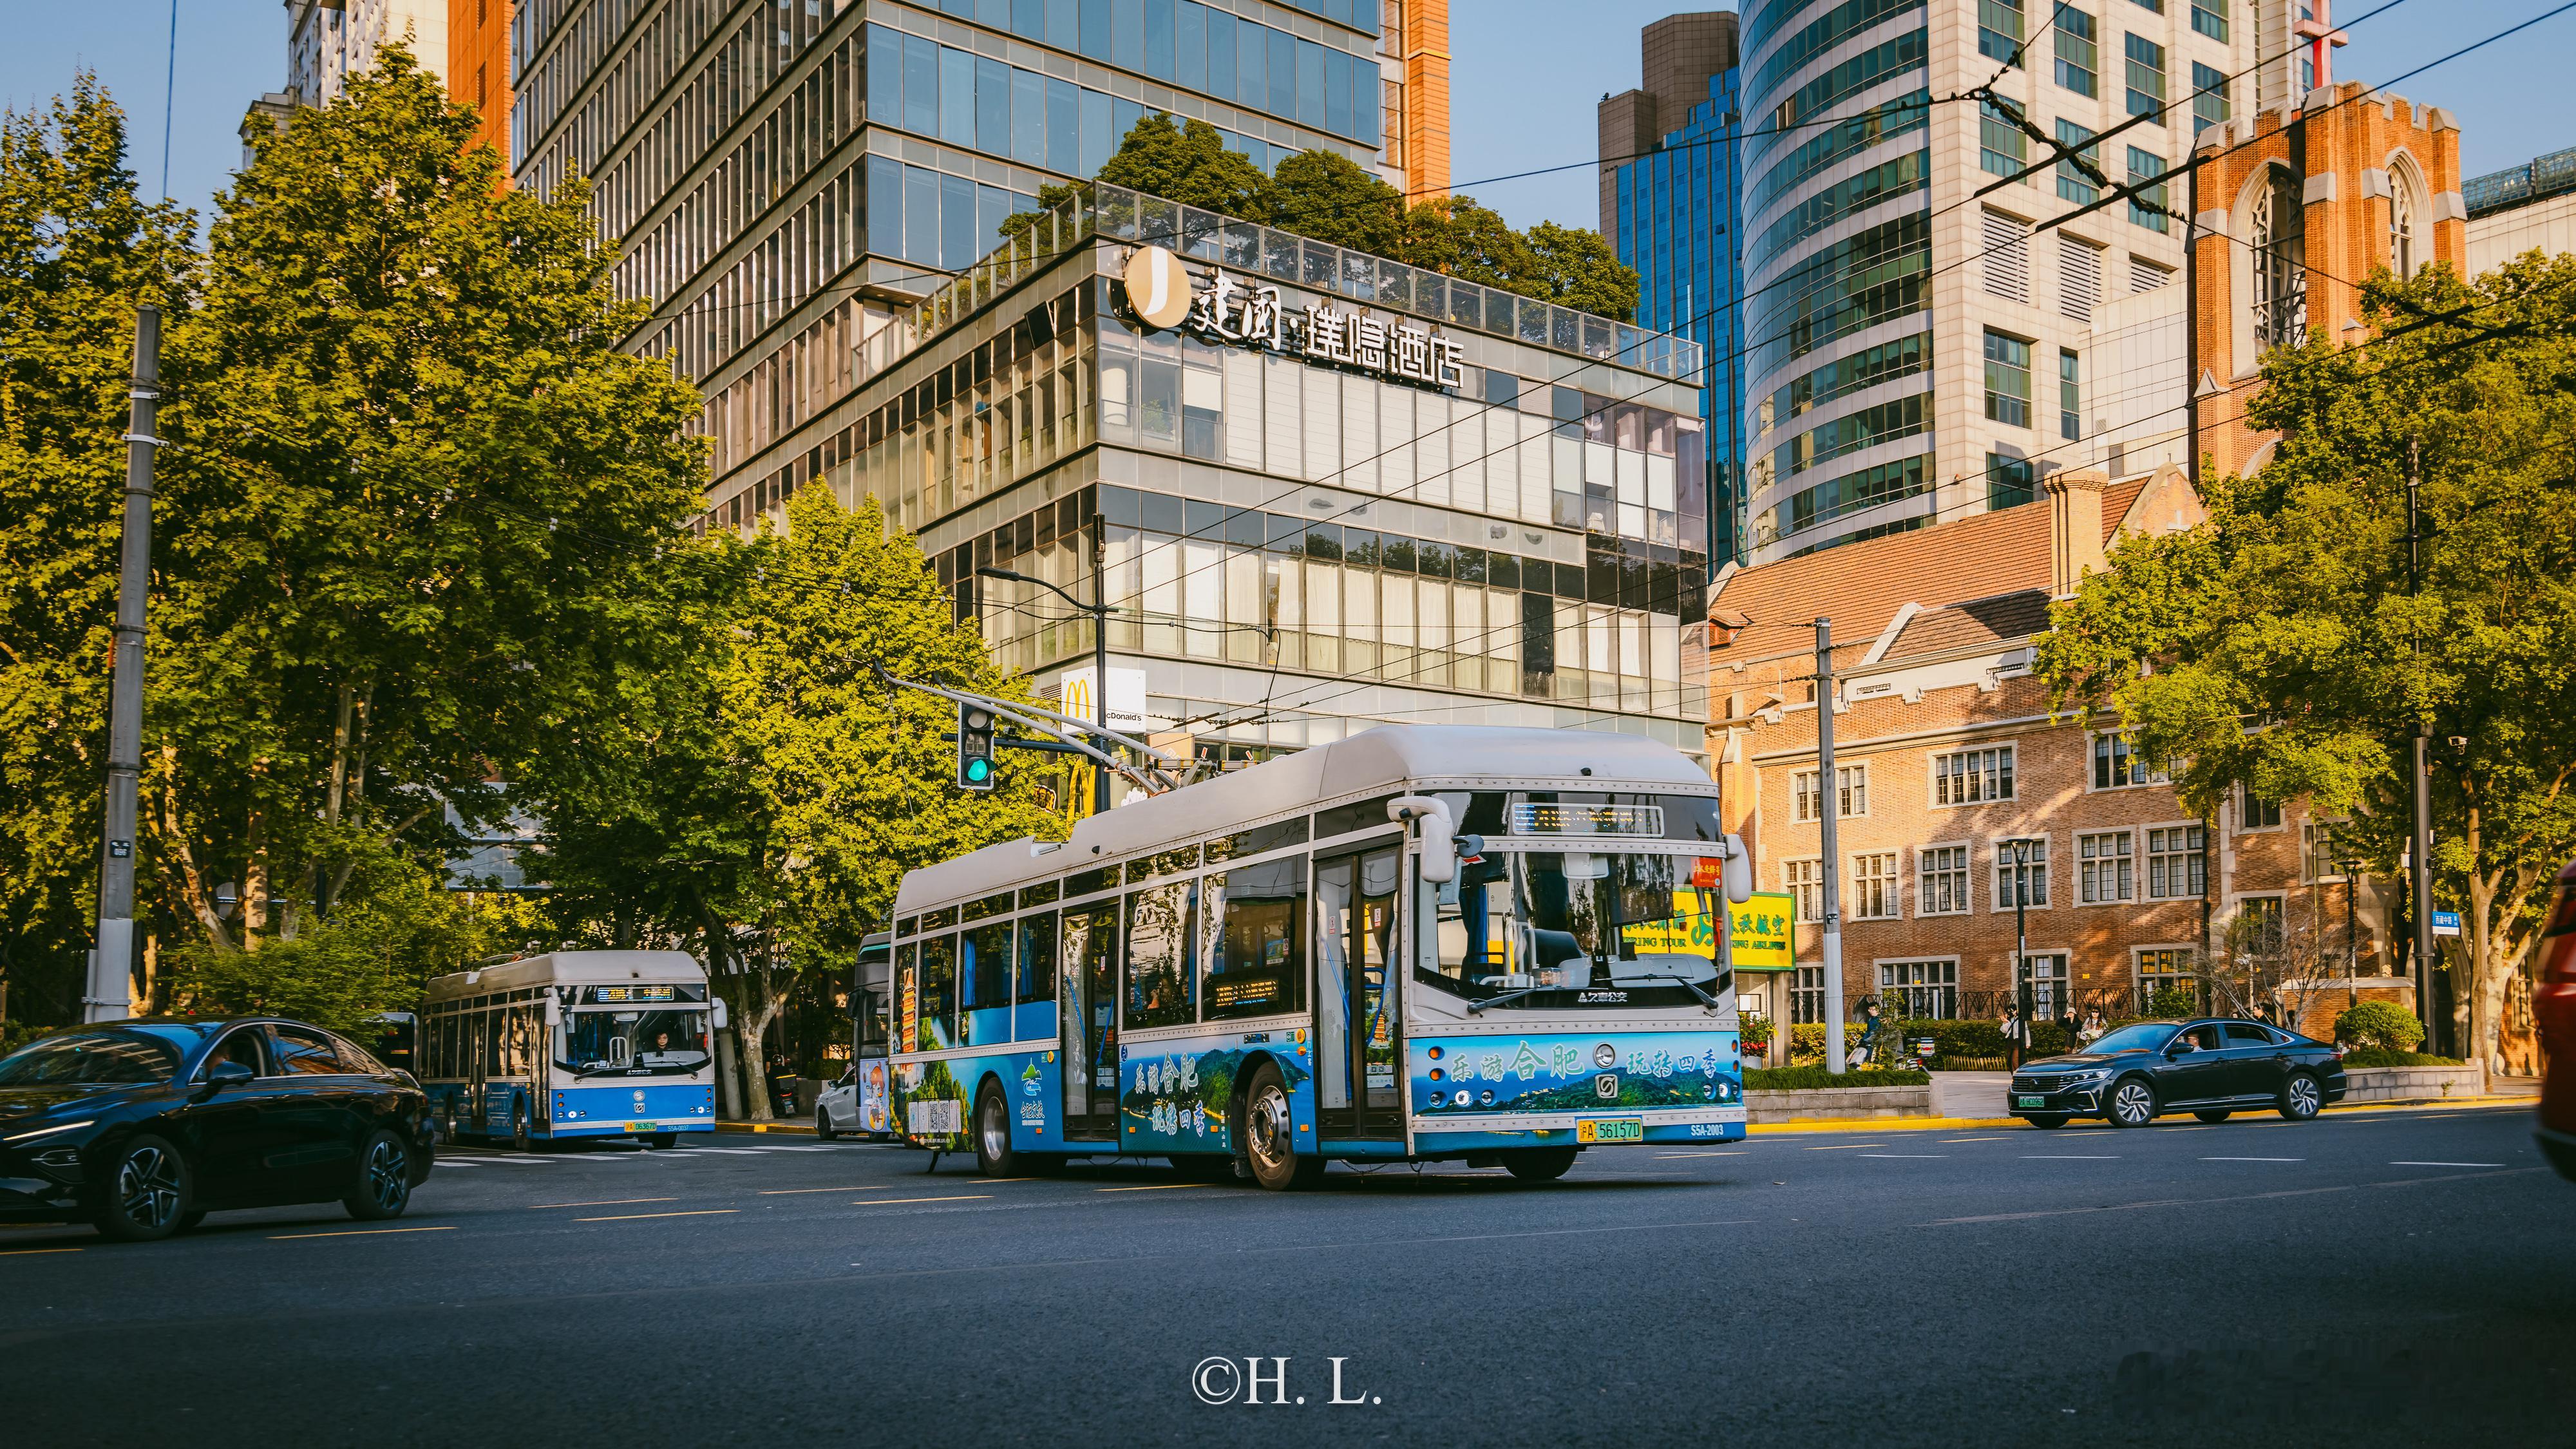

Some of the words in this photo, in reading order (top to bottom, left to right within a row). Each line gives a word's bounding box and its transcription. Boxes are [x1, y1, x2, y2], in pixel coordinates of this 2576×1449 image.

[1106, 712, 1142, 721] cDonald's
[1135, 1050, 1198, 1094] 乐游合肥
[1450, 1041, 1584, 1082] 乐游合肥
[1627, 1048, 1718, 1078] 玩转四季
[1152, 1100, 1206, 1137] 玩转四季
[1690, 1124, 1724, 1136] S5A-2003
